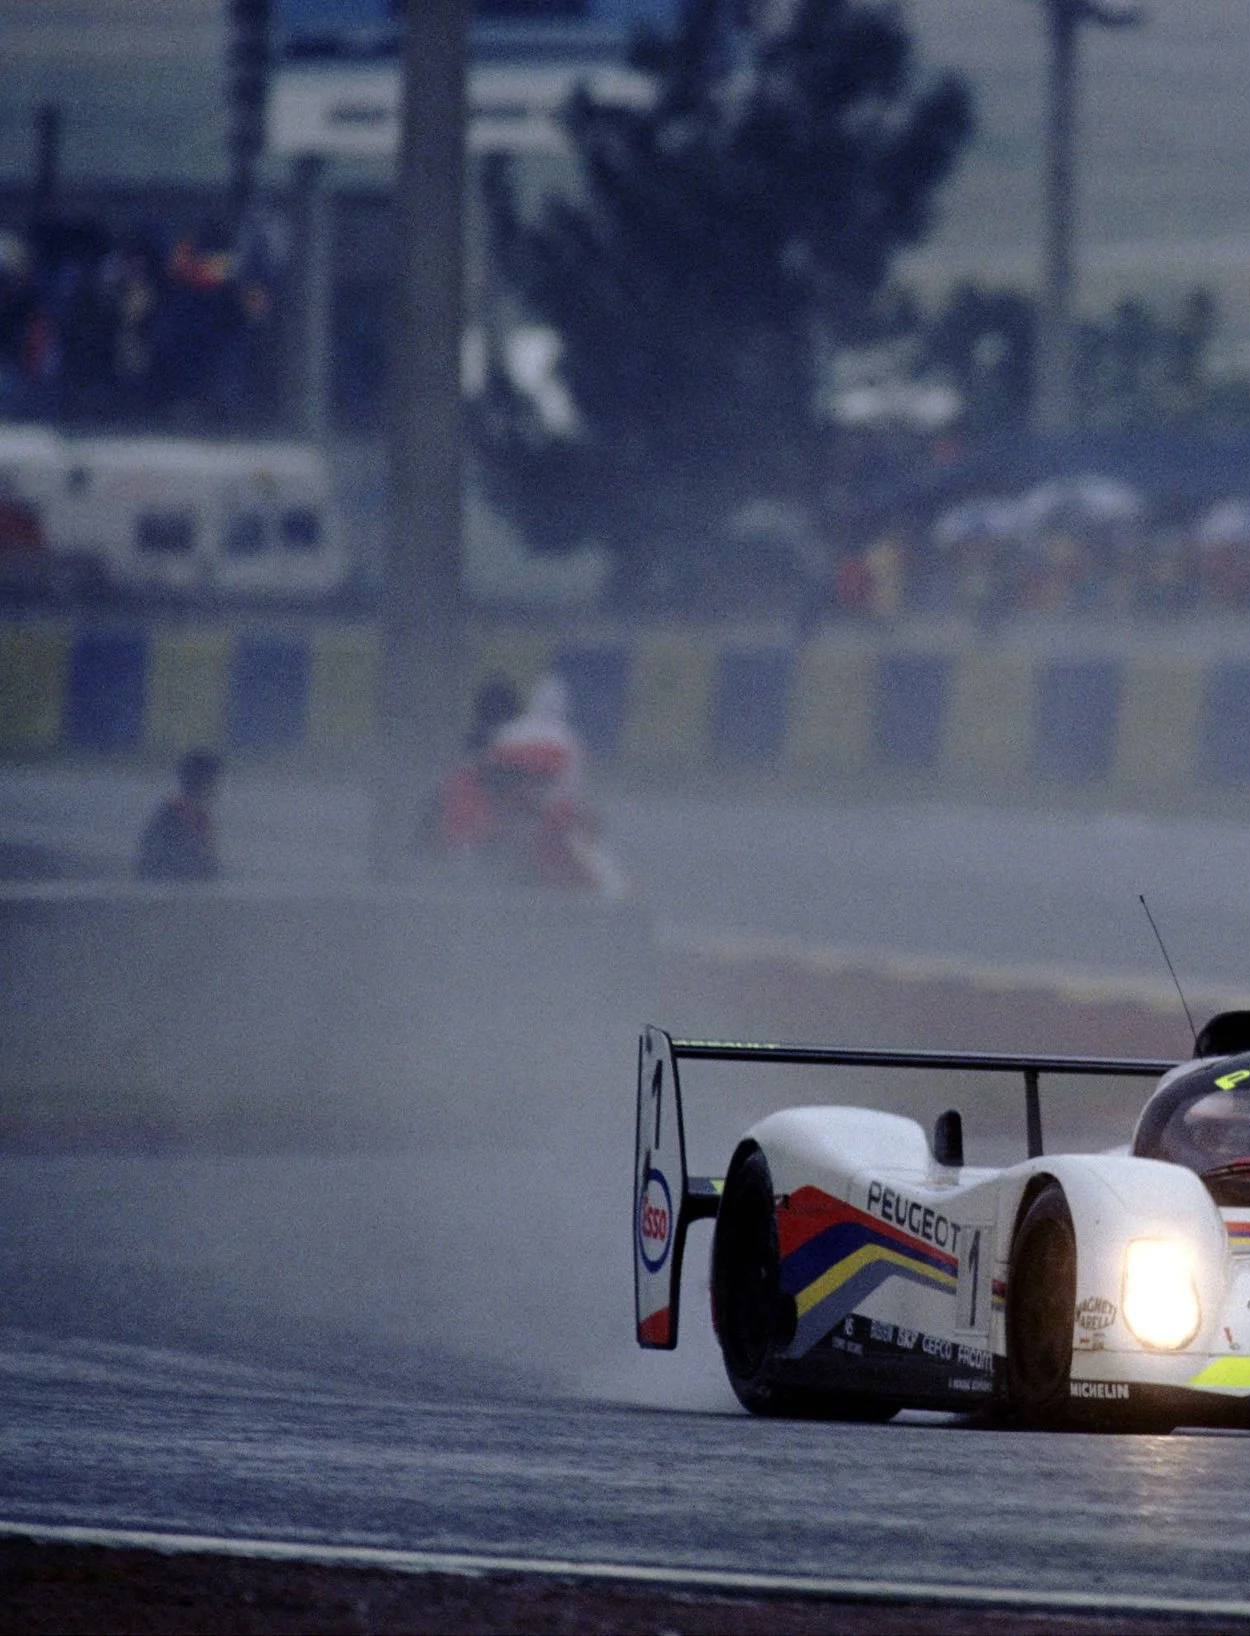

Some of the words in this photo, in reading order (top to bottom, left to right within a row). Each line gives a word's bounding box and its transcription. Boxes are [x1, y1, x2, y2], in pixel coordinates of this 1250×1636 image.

[867, 1180, 961, 1252] PEUGEOT
[968, 1230, 981, 1327] 1
[1070, 1382, 1130, 1399] MICHELIN
